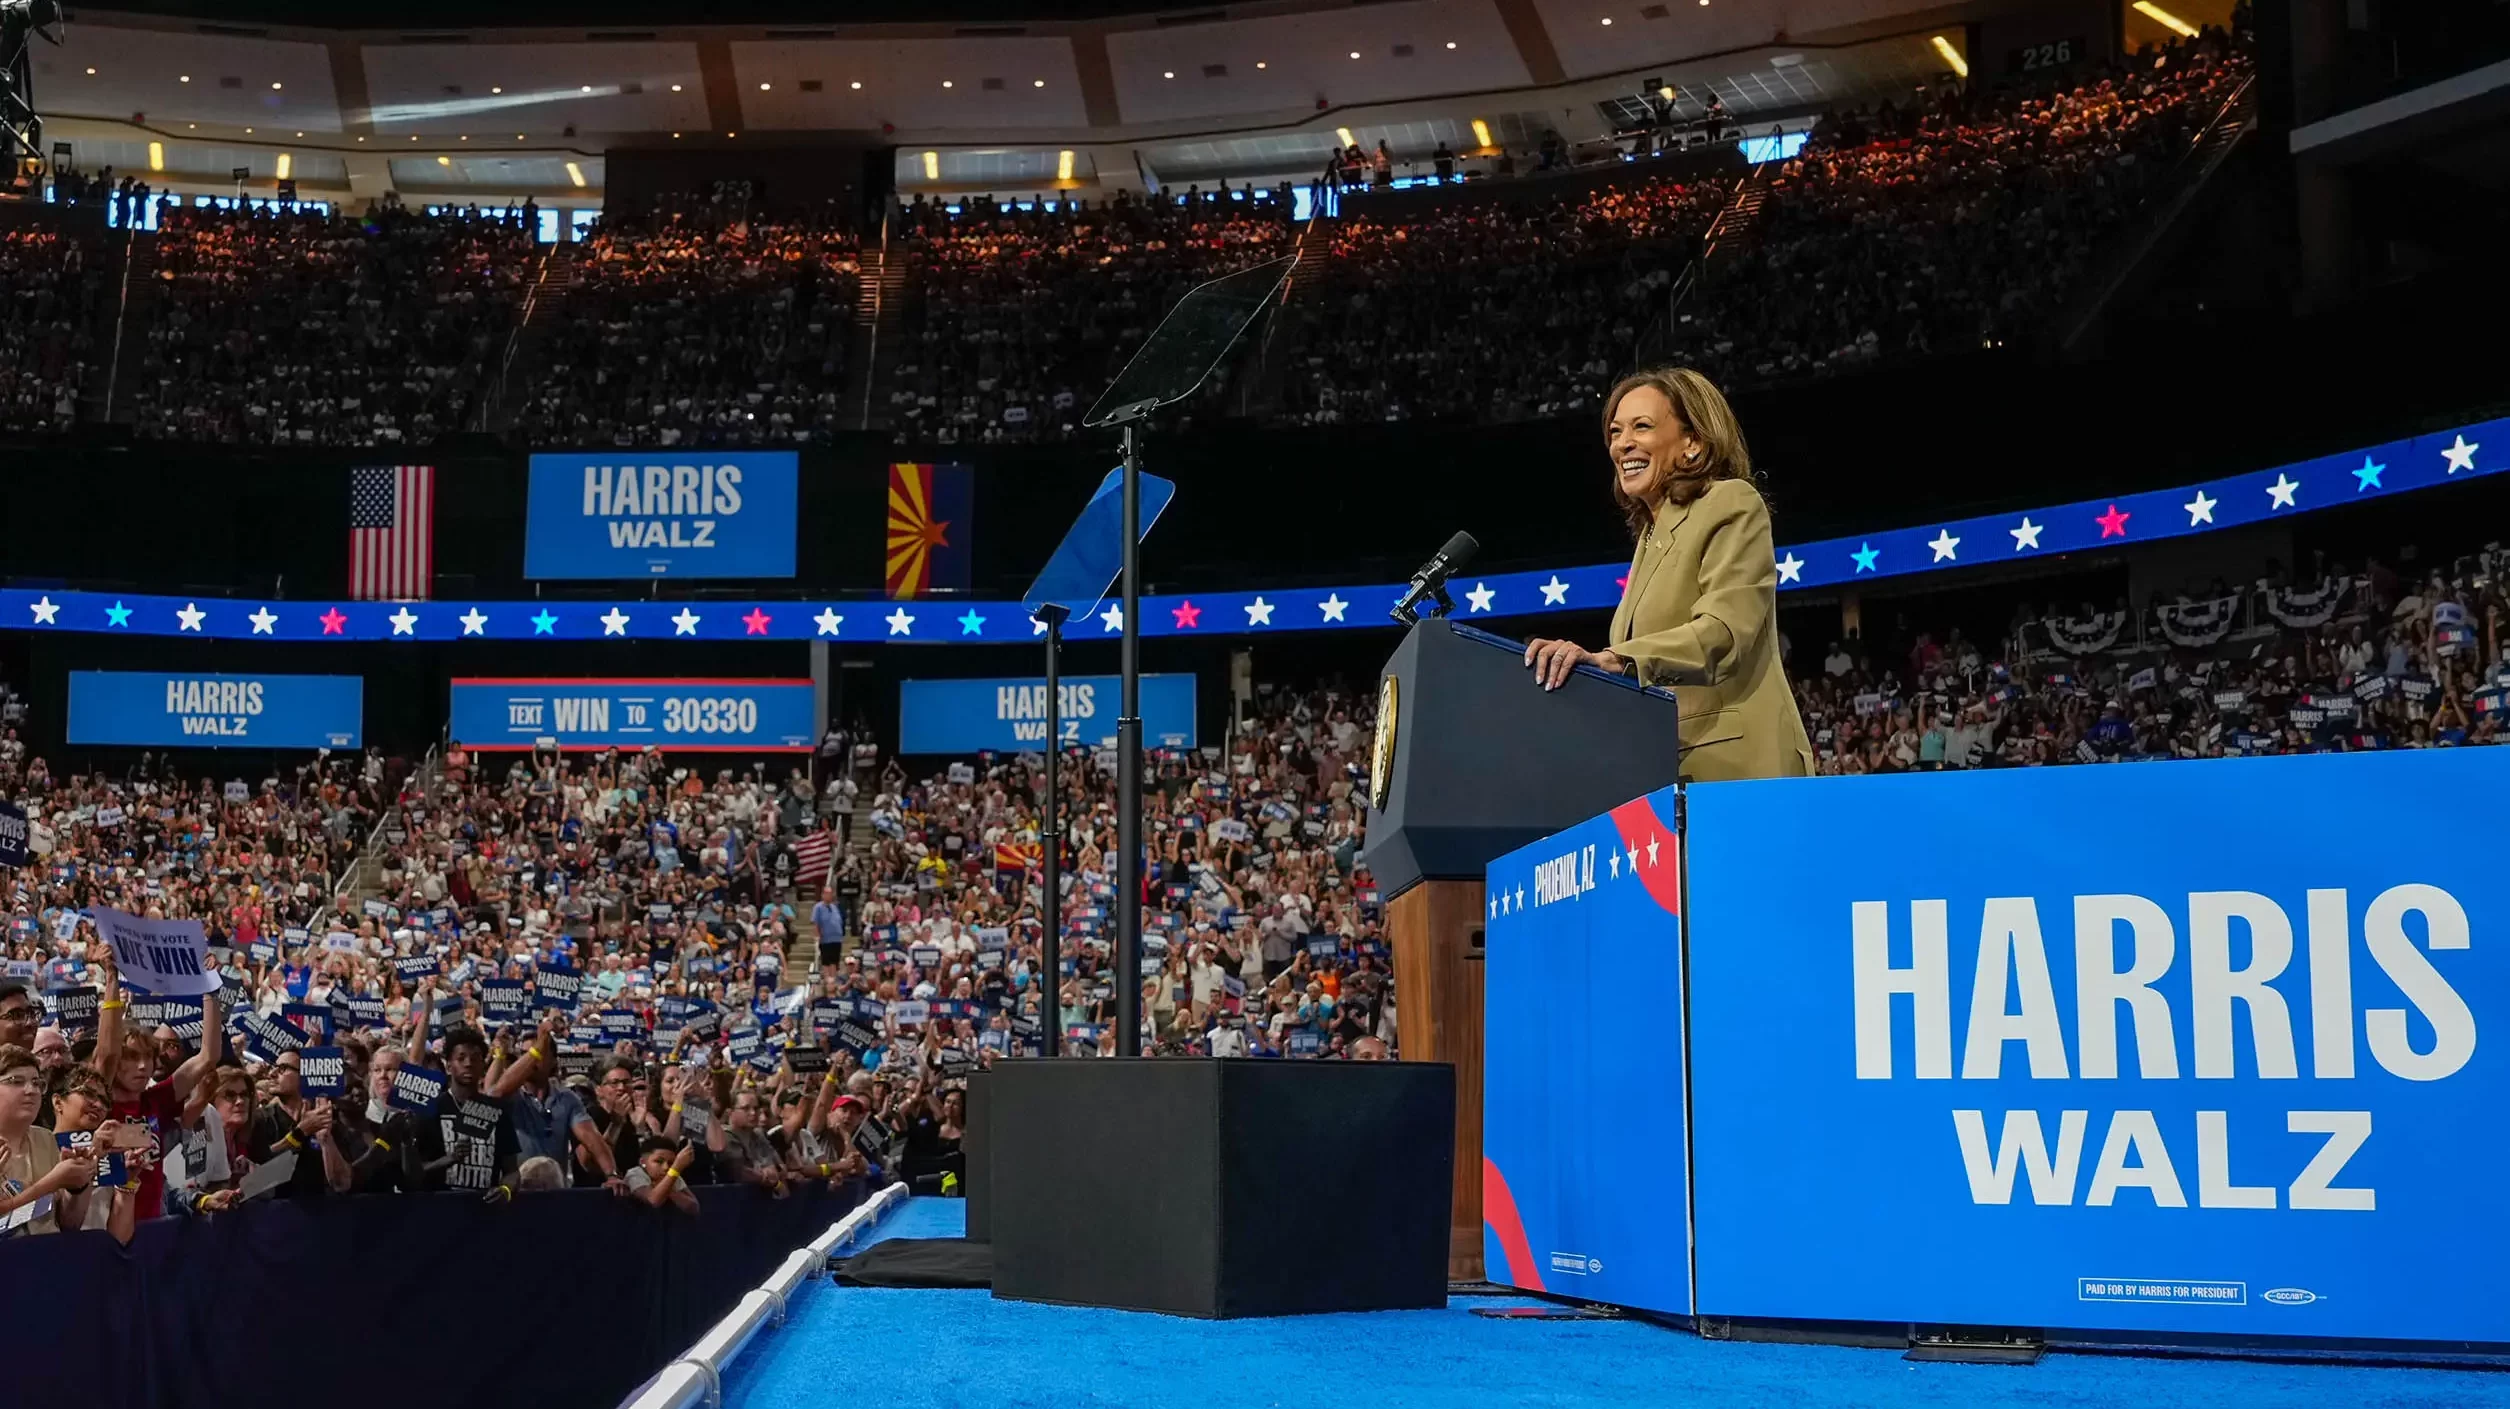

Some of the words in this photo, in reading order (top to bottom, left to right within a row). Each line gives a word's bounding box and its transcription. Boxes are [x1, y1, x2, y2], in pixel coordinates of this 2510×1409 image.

[2022, 40, 2071, 71] 226
[583, 465, 742, 516] HARRIS
[608, 521, 715, 548] WALZ
[166, 680, 263, 715] HARRIS
[997, 684, 1095, 719] HARRIS
[508, 705, 543, 724] TEXT
[553, 698, 609, 732] WIN
[627, 706, 646, 725] TO
[663, 698, 757, 734] 30330
[2290, 710, 2323, 722] HARRIS
[182, 717, 247, 735] WALZ
[1014, 722, 1080, 741] WAZ
[0, 813, 27, 840] RIS
[1535, 851, 1580, 907] PHOENIX,
[1581, 844, 1595, 892] AZ
[112, 923, 141, 940] WHEN
[142, 932, 158, 944] WE
[160, 934, 192, 945] VOTE
[113, 934, 148, 970] WE
[147, 945, 201, 976] WIN
[394, 956, 437, 970] HARRIS
[404, 964, 433, 973] WALZ
[537, 971, 579, 992] HARRIS
[1852, 883, 2476, 1081] HARRIS
[57, 994, 97, 1012] HARRIS
[218, 986, 237, 1005] RIS
[482, 988, 523, 1003] HARRIS
[542, 988, 571, 1000] WALZ
[64, 1008, 91, 1019] WALZ
[131, 1004, 162, 1018] HARR
[348, 1000, 385, 1013] HARRIS
[356, 1011, 380, 1019] WALZ
[490, 1002, 517, 1011] WALZ
[140, 1019, 159, 1028] WAL
[172, 1021, 203, 1039] HAR
[261, 1038, 281, 1057] WAL
[300, 1058, 344, 1076] HARRIS
[307, 1076, 338, 1087] WALZ
[394, 1071, 441, 1098] HARRIS
[398, 1089, 429, 1106] WALZ
[460, 1100, 503, 1122] HARRIS
[463, 1116, 489, 1130] WALZ
[1952, 1110, 2376, 1210] WALZ
[445, 1164, 492, 1188] MATTER
[2086, 1283, 2105, 1295] PAID
[2108, 1284, 2124, 1296] FOR
[2125, 1285, 2138, 1296] BY
[2139, 1285, 2171, 1297] HARRIS
[2173, 1286, 2190, 1297] FOR
[2191, 1287, 2239, 1299] PRESIDENT
